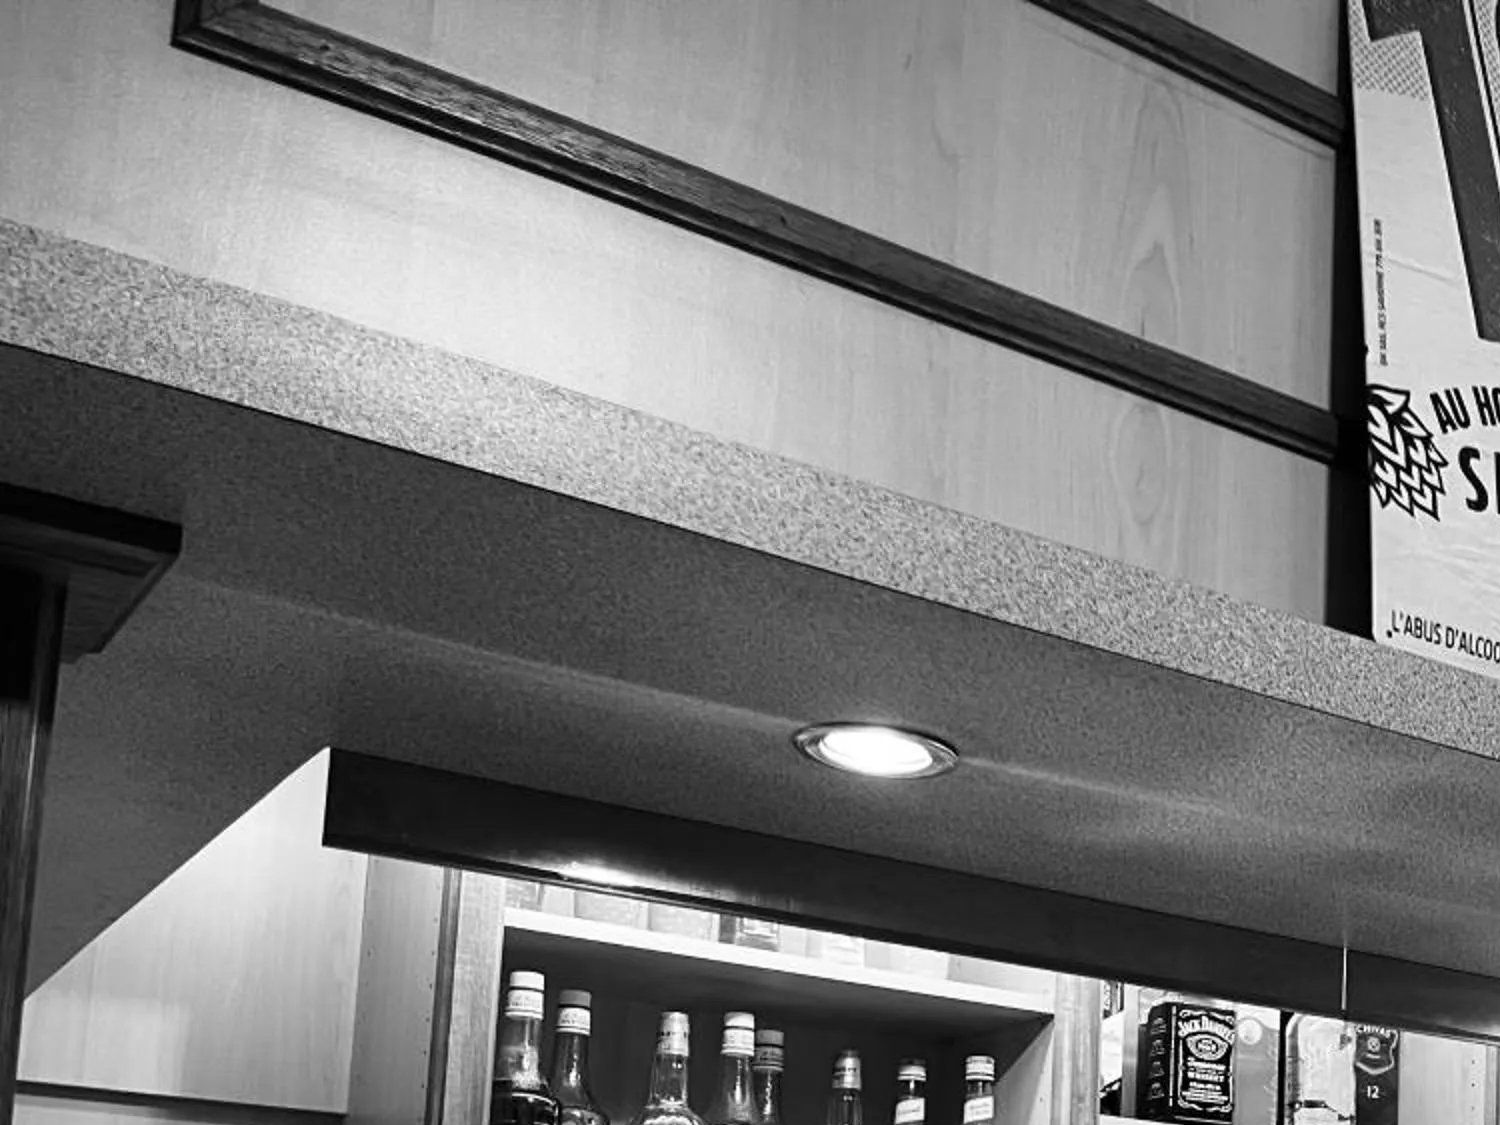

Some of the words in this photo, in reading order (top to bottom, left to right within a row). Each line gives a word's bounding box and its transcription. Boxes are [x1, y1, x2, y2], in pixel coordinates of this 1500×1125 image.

[1429, 387, 1471, 434] AU
[1391, 609, 1441, 645] L'ABUS
[1367, 1085, 1380, 1099] 12
